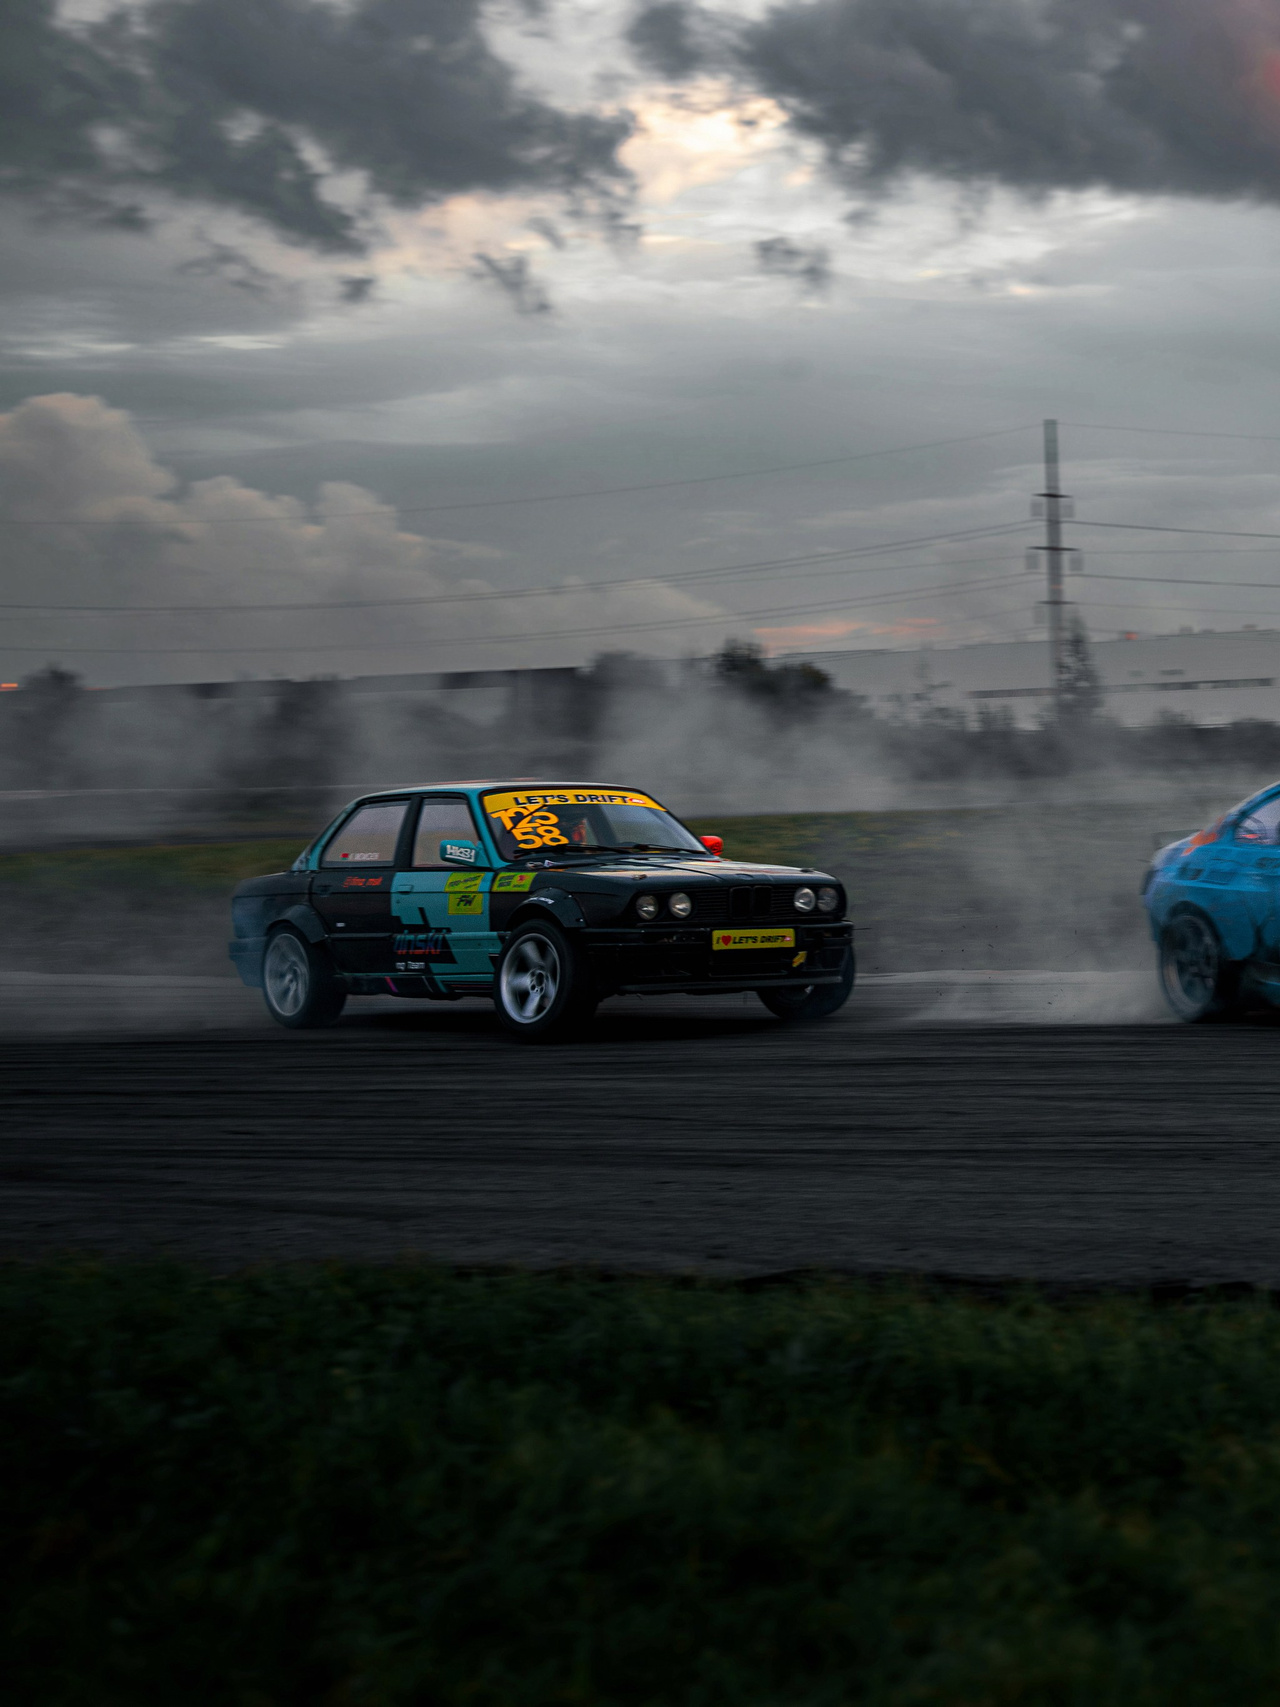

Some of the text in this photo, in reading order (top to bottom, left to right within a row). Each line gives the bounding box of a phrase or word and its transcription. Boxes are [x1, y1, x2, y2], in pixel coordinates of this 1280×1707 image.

[513, 794, 630, 806] LET'S DRIFT
[511, 826, 569, 849] 58
[732, 936, 758, 944] LET'S
[760, 935, 786, 943] DRIFT
